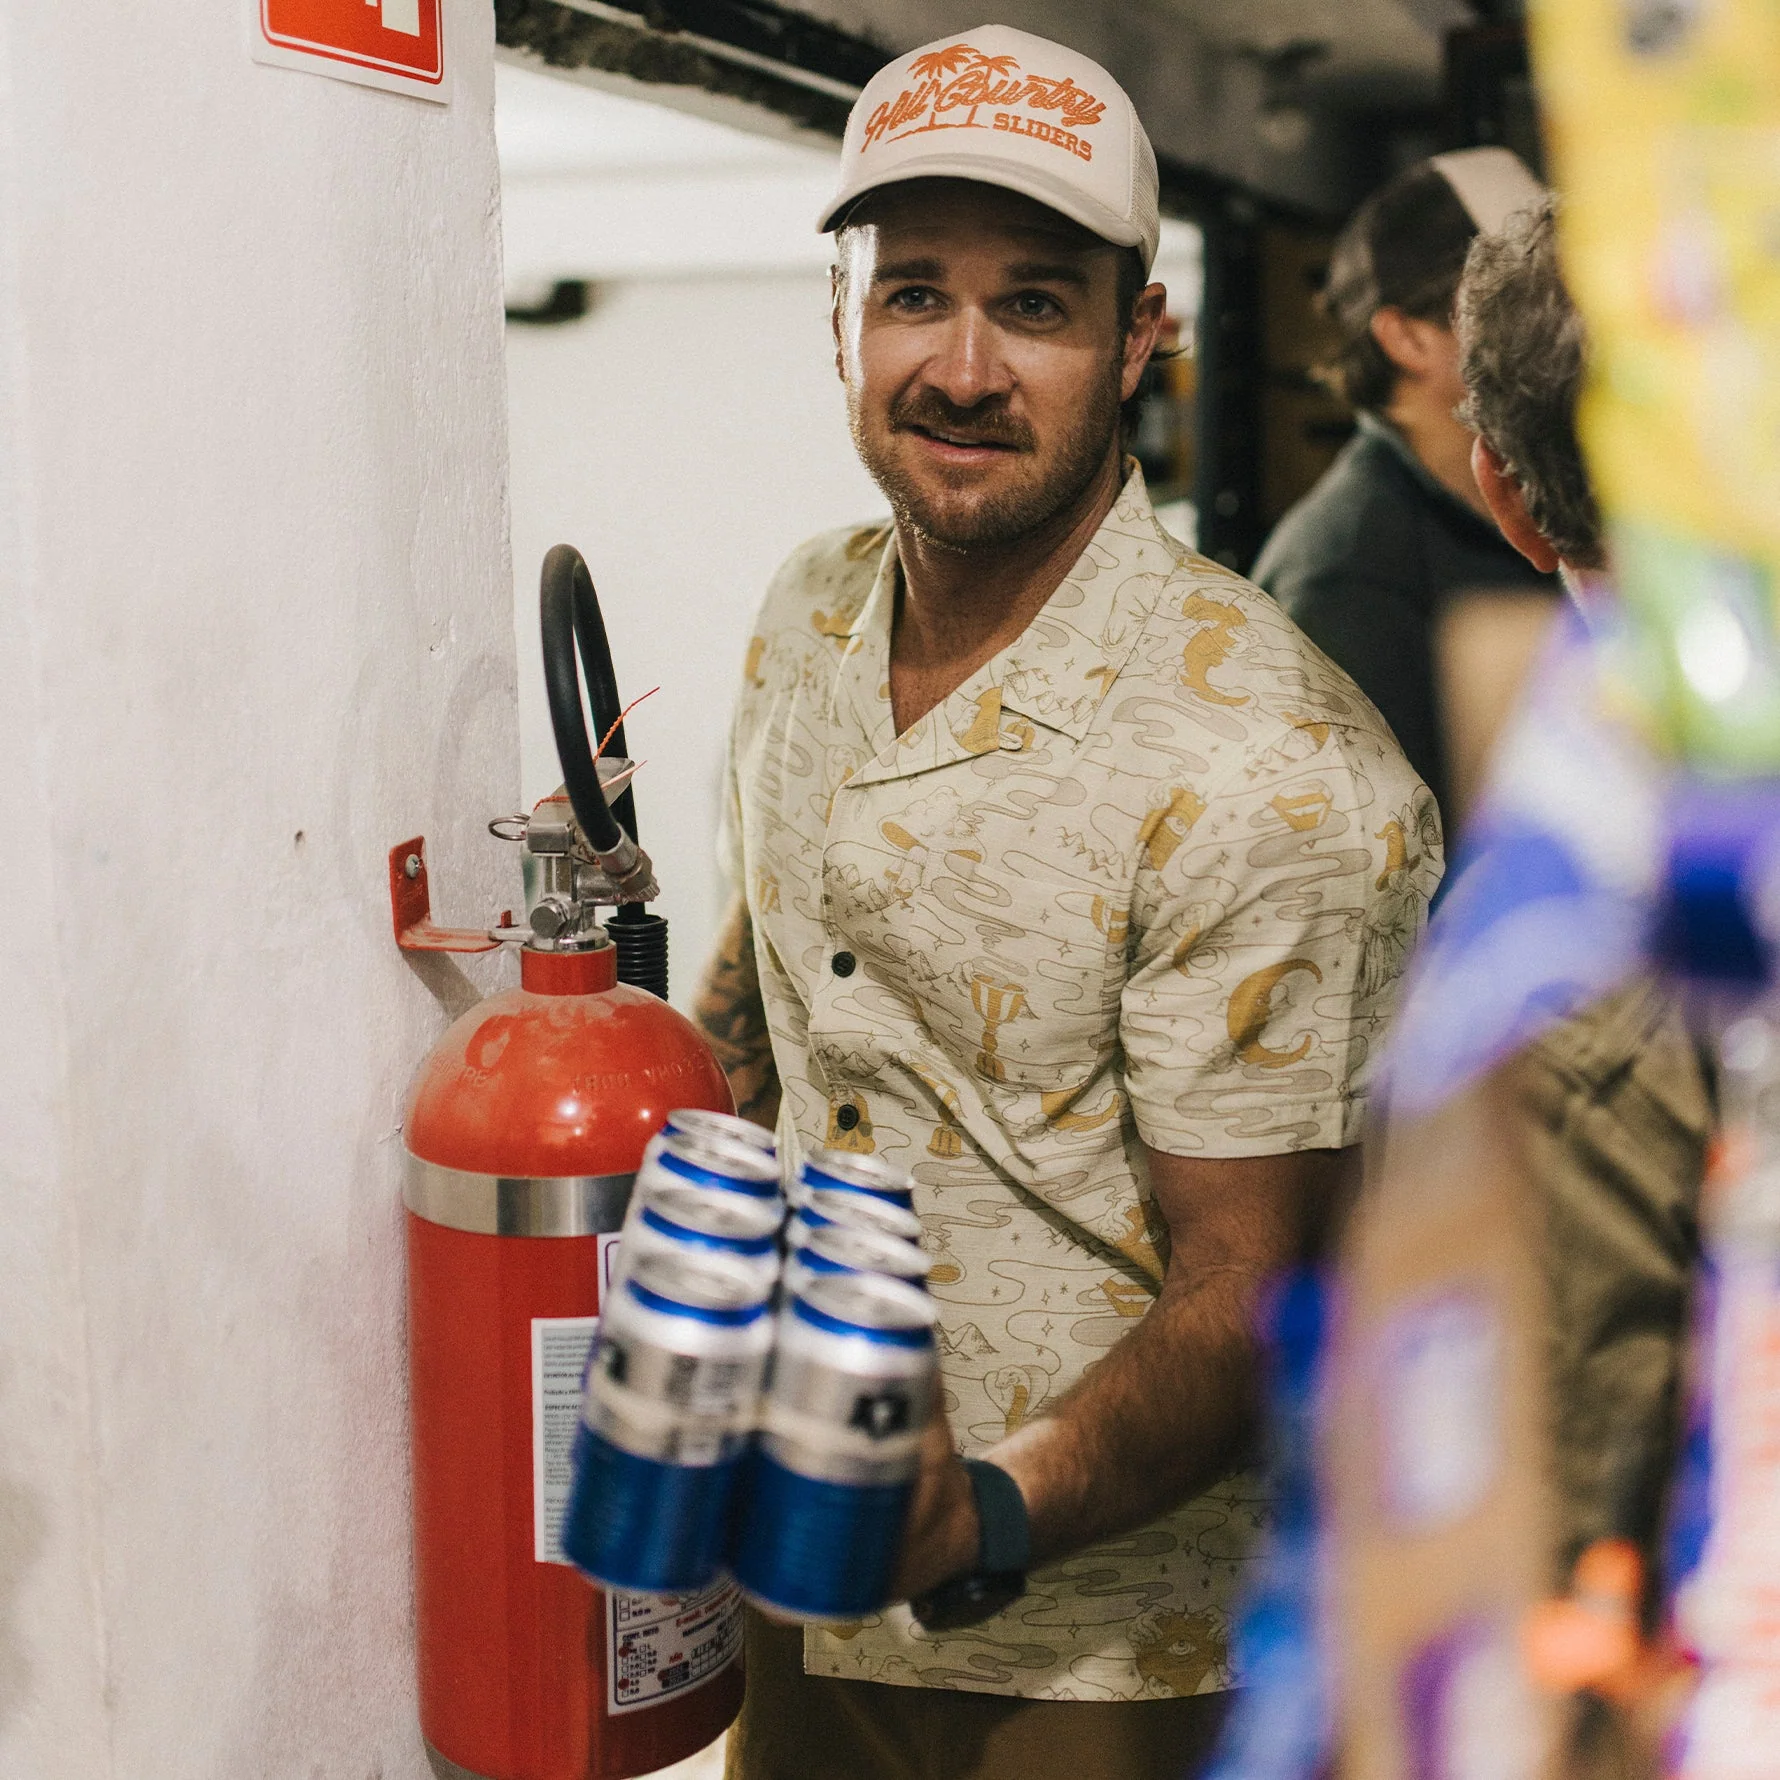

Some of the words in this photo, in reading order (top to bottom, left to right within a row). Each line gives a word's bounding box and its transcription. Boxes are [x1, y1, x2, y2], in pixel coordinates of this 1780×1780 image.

[861, 79, 941, 153] Hill
[933, 70, 1107, 127] Country
[992, 112, 1092, 162] SLIDERS
